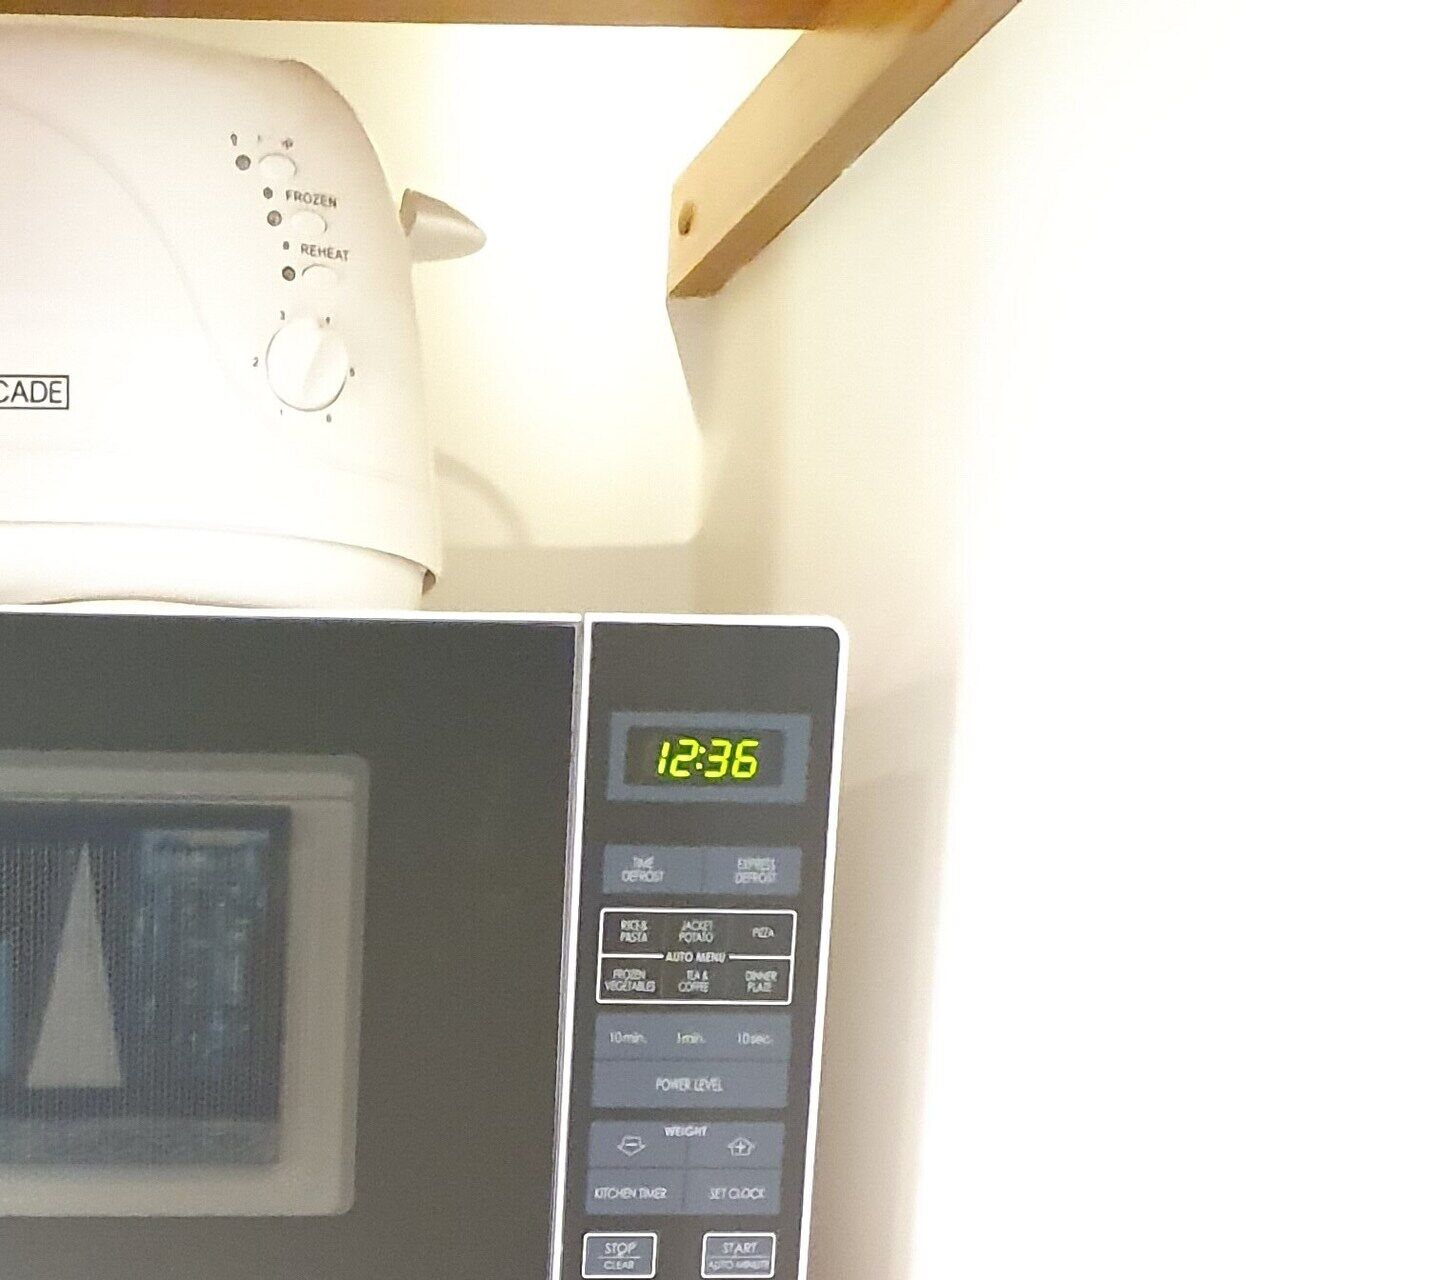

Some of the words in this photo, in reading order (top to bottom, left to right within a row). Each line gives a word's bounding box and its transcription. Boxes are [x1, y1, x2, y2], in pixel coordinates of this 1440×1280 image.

[285, 189, 338, 209] FROZEN
[300, 243, 350, 262] REHEAT
[656, 738, 759, 779] 12:36
[665, 951, 694, 963] AUTO
[696, 952, 726, 964] MENU
[656, 1077, 691, 1091] POWER
[694, 1078, 723, 1092] LEVEL
[664, 1126, 707, 1137] WEIGHT
[594, 1187, 637, 1200] KITCHEN
[639, 1187, 667, 1200] TIMER
[709, 1188, 727, 1200] SET
[729, 1188, 765, 1200] CLOCK
[605, 1242, 637, 1255] STOP
[722, 1242, 758, 1254] START
[603, 1260, 635, 1271] CLEAR
